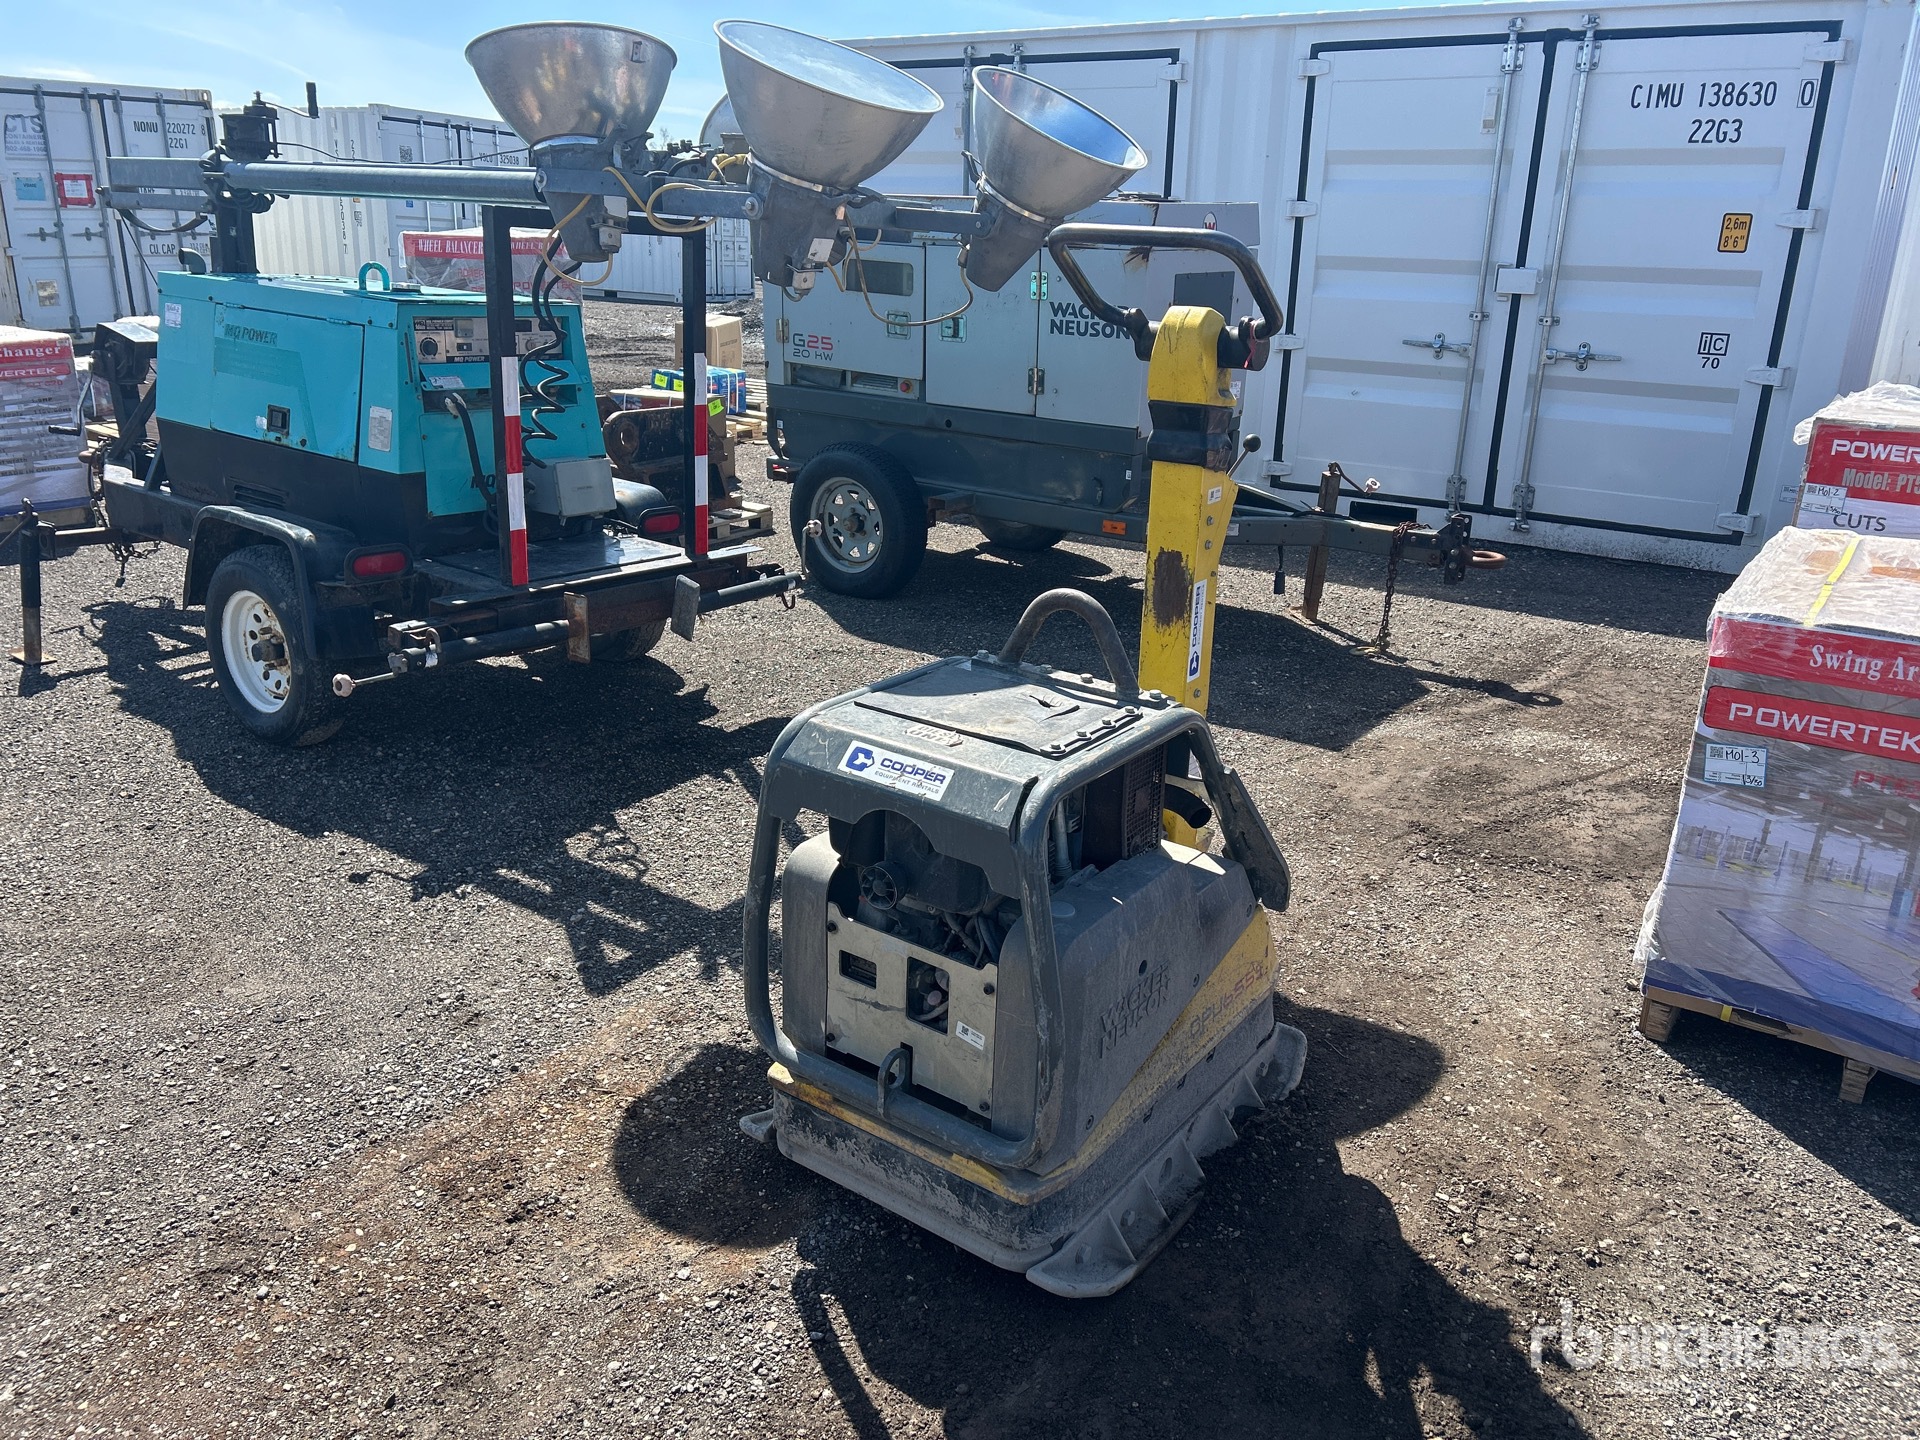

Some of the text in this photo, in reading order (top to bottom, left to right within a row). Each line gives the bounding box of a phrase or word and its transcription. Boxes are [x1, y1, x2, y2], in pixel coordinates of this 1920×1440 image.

[1630, 80, 1815, 108] CIMU 138630 0
[5, 114, 44, 133] CTS
[133, 121, 206, 136] NONU 220272 8
[1687, 118, 1743, 143] 22G3
[168, 137, 188, 149] 22G1
[500, 154, 520, 166] 325038
[1725, 217, 1748, 232] 2,6m
[418, 239, 484, 255] WHEEL BALANCER
[242, 327, 278, 345] POWER
[793, 333, 834, 351] G25
[793, 348, 810, 358] 20
[1701, 357, 1720, 369] 70
[1842, 467, 1891, 490] Model:
[1833, 512, 1887, 532] CUTS
[1191, 585, 1201, 648] COOPER
[1809, 644, 1884, 681] Swing
[1728, 702, 1920, 754] POWERTEK
[880, 757, 947, 785] COOPER
[874, 769, 940, 794] EQUIPMENT RENTALS
